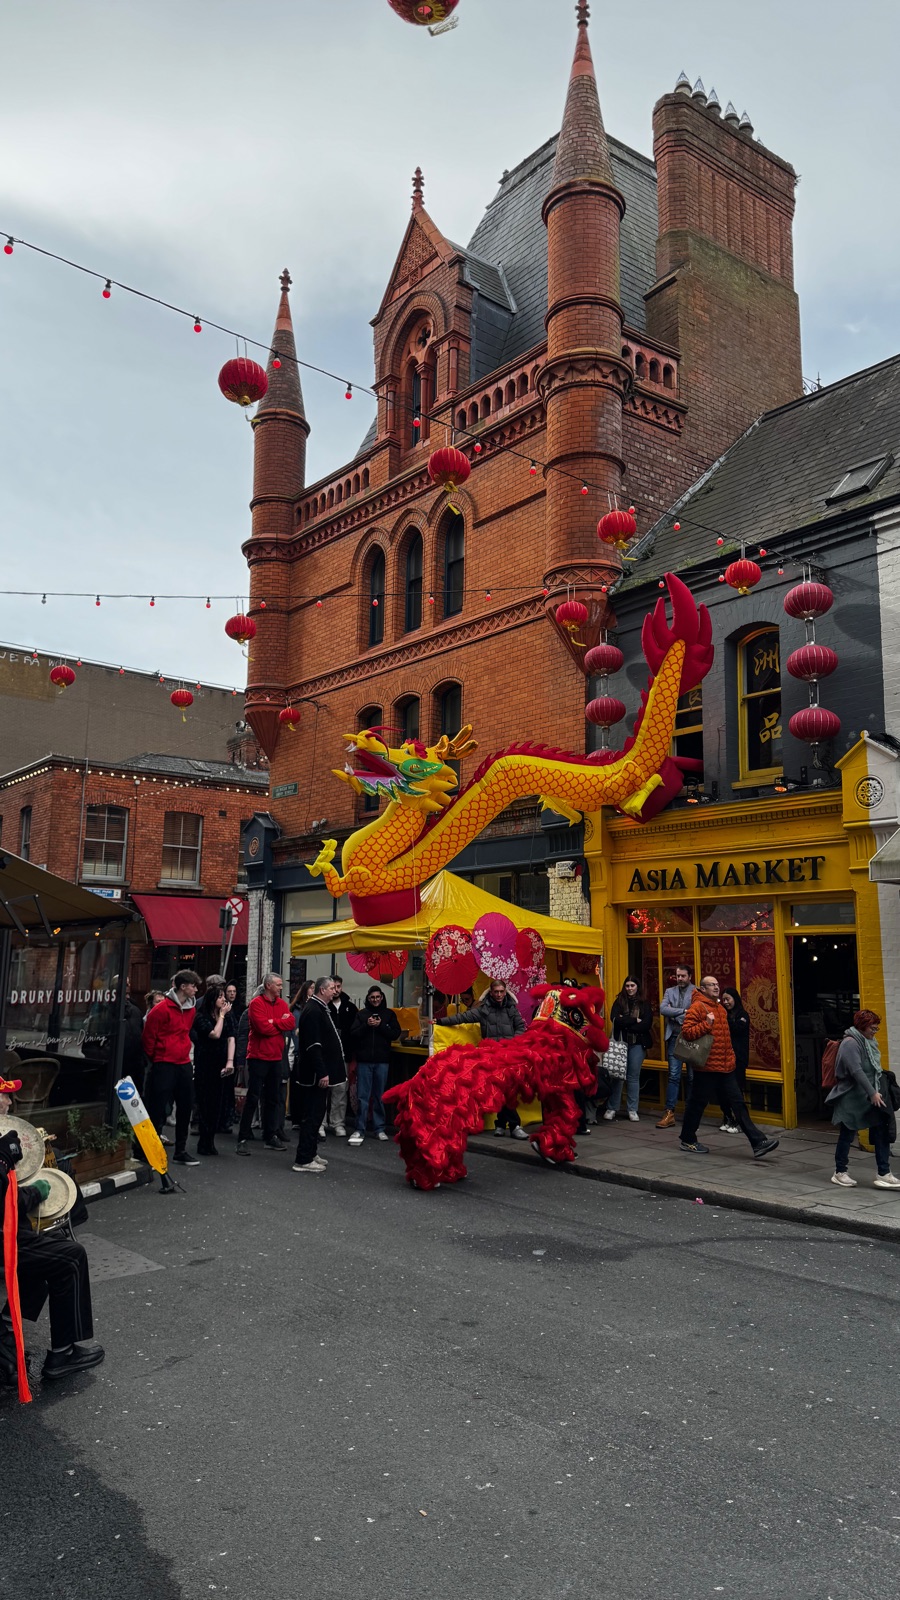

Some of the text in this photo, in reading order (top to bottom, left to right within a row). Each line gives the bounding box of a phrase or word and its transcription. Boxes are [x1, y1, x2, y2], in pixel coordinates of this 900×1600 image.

[759, 712, 783, 744] 品
[627, 856, 826, 892] ASIA MARKET
[703, 948, 730, 957] APPY
[10, 989, 117, 1005] DRURY BUILDINGS
[8, 1029, 108, 1051] Bar Lounge Dining
